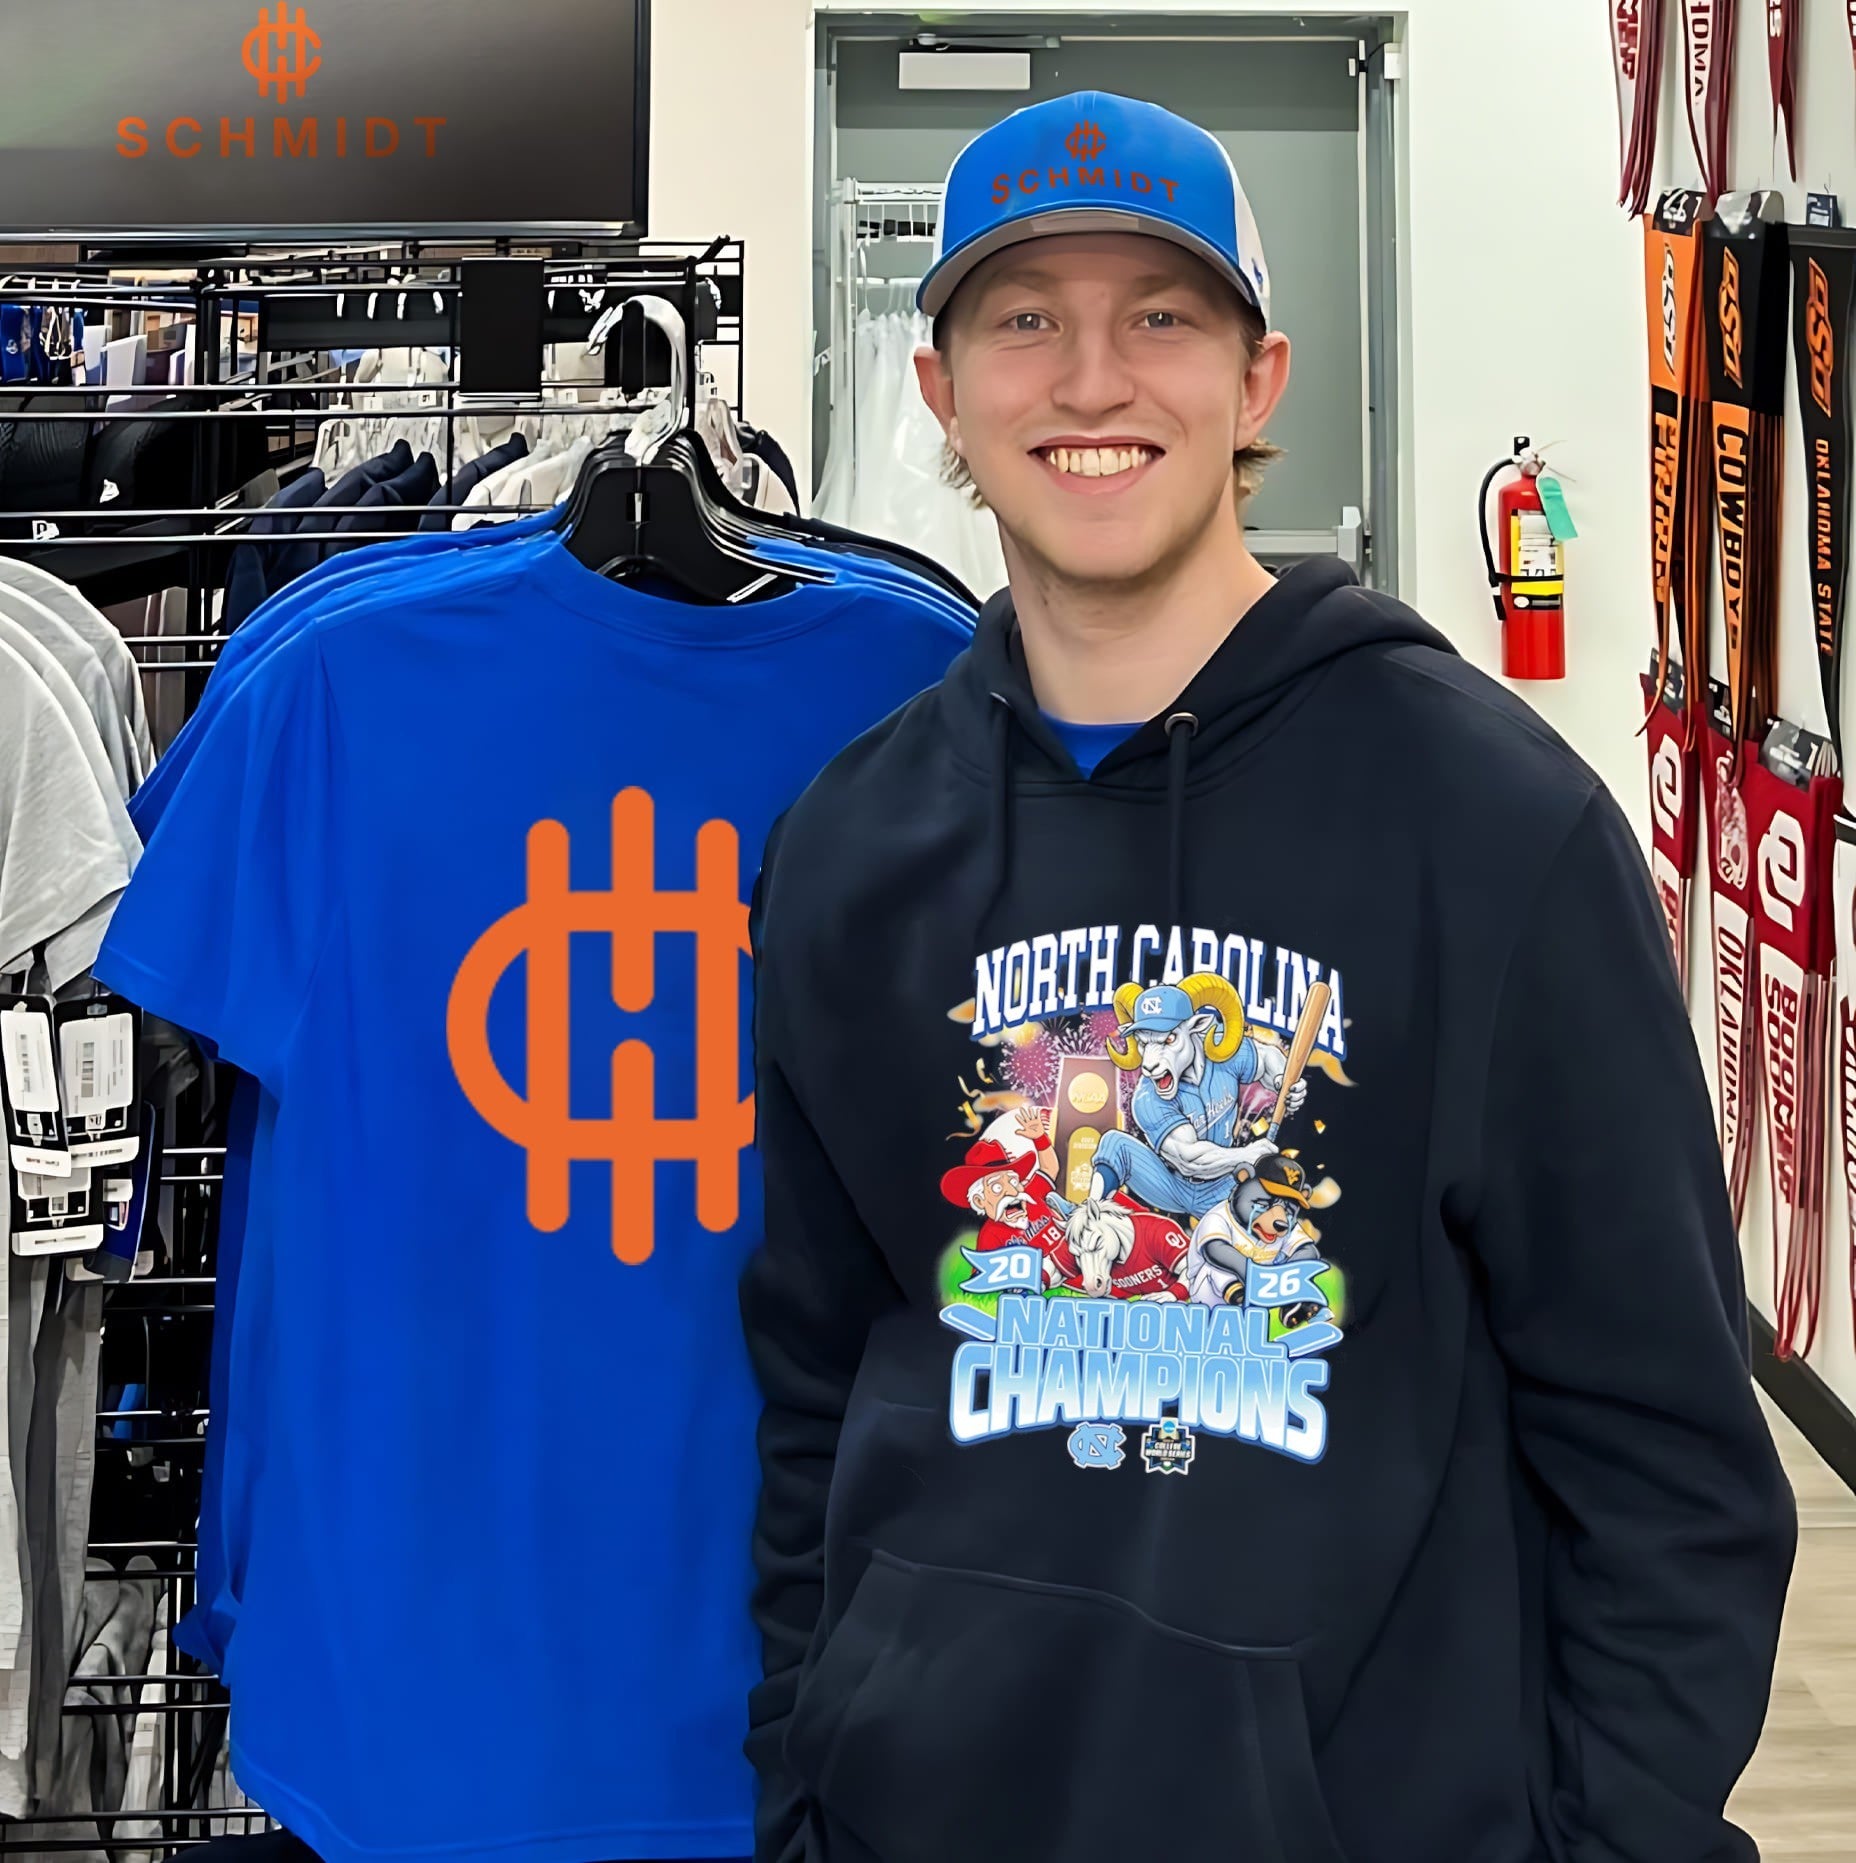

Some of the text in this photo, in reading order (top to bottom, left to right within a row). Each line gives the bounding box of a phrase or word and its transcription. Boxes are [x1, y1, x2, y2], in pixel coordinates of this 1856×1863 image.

[115, 117, 447, 158] SCHMIDT
[991, 167, 1179, 204] SCHMIDT
[1815, 439, 1832, 570] OKLAHOMA
[971, 924, 1121, 1038] NORTH
[1718, 926, 1744, 1143] OKLAHOMA
[1042, 1226, 1061, 1246] 18
[988, 1253, 1031, 1283] 20
[1112, 1265, 1163, 1289] SOONERS
[1258, 1269, 1300, 1298] 26
[1000, 1296, 1288, 1358] NATIONAL
[951, 1344, 1330, 1462] CHAMPIONS
